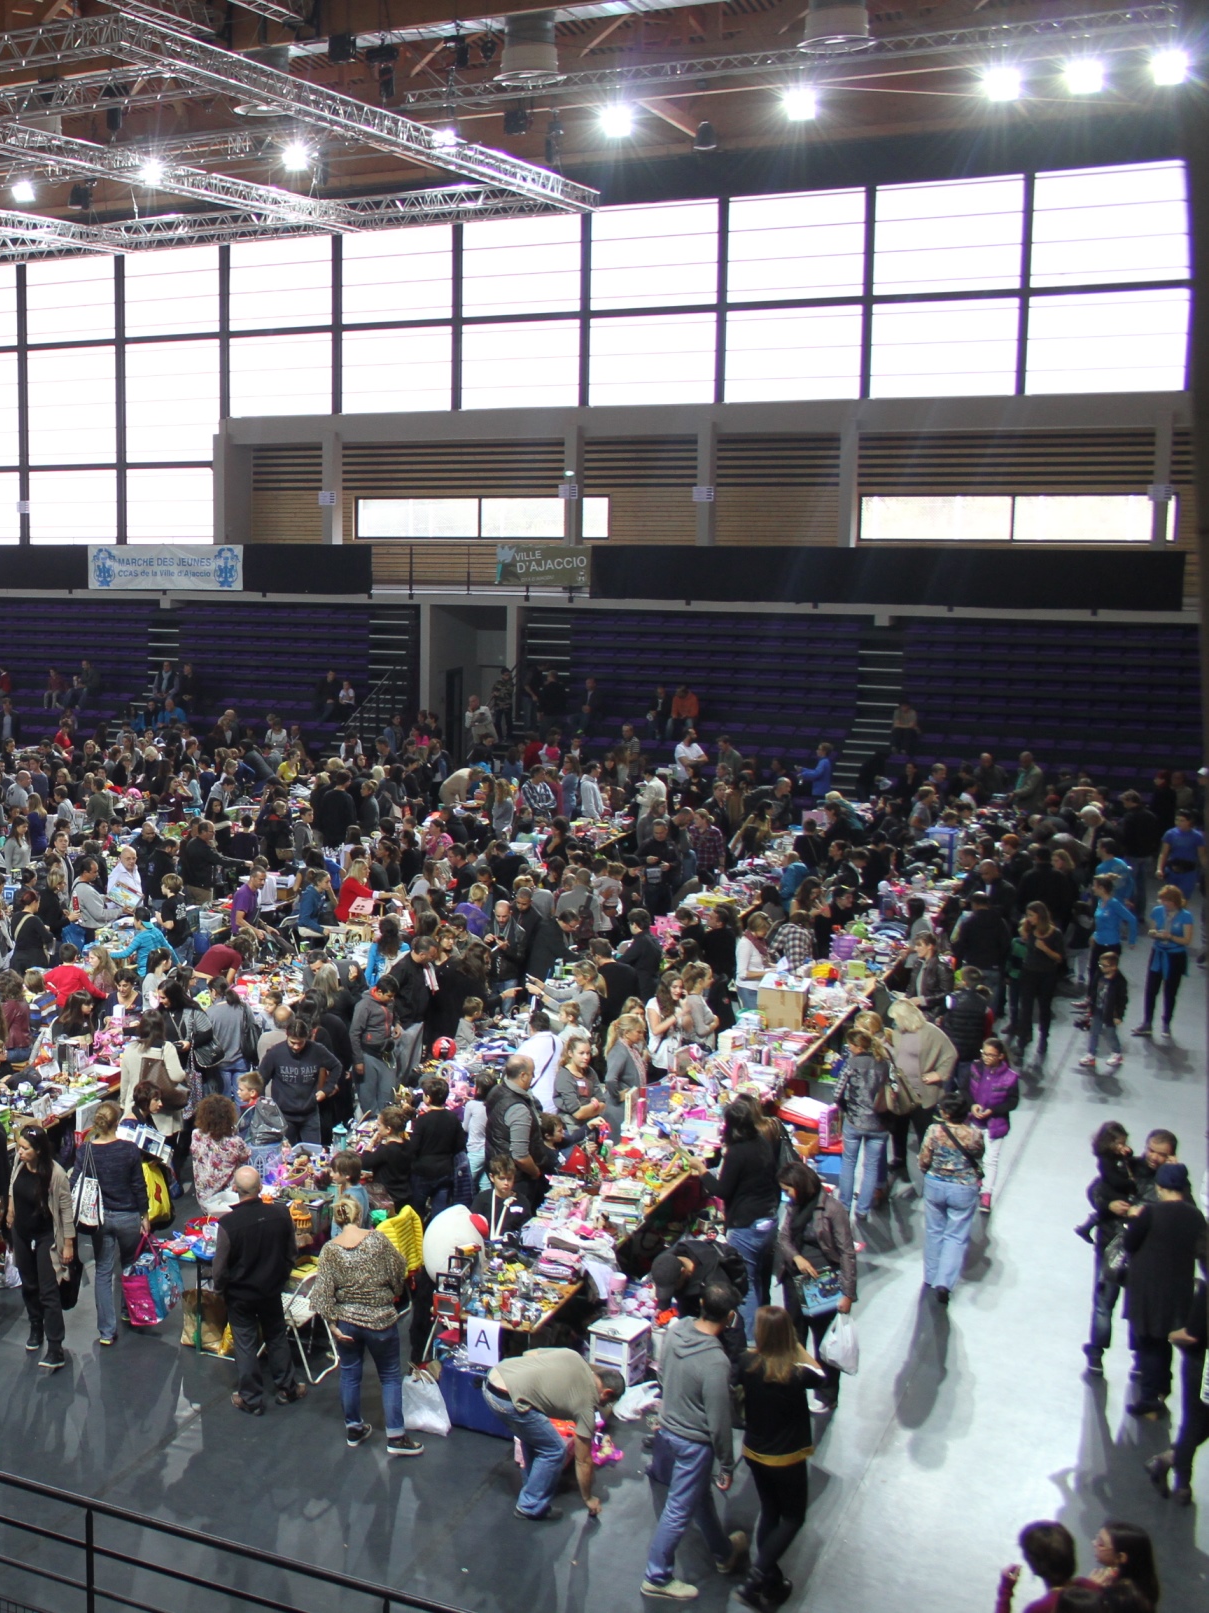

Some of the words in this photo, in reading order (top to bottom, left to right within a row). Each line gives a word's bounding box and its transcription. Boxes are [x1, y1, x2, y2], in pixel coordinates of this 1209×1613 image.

[118, 555, 154, 567] MARCHÉ
[156, 557, 174, 567] DES
[176, 557, 212, 567] JEUNES
[515, 550, 542, 561] VILLE
[516, 556, 587, 573] D'AJACCIO
[117, 569, 139, 577] CCAS
[140, 569, 150, 577] de
[151, 569, 158, 577] la
[159, 569, 175, 577] Ville
[177, 569, 211, 579] d'Ajaccio
[474, 1329, 491, 1351] A
